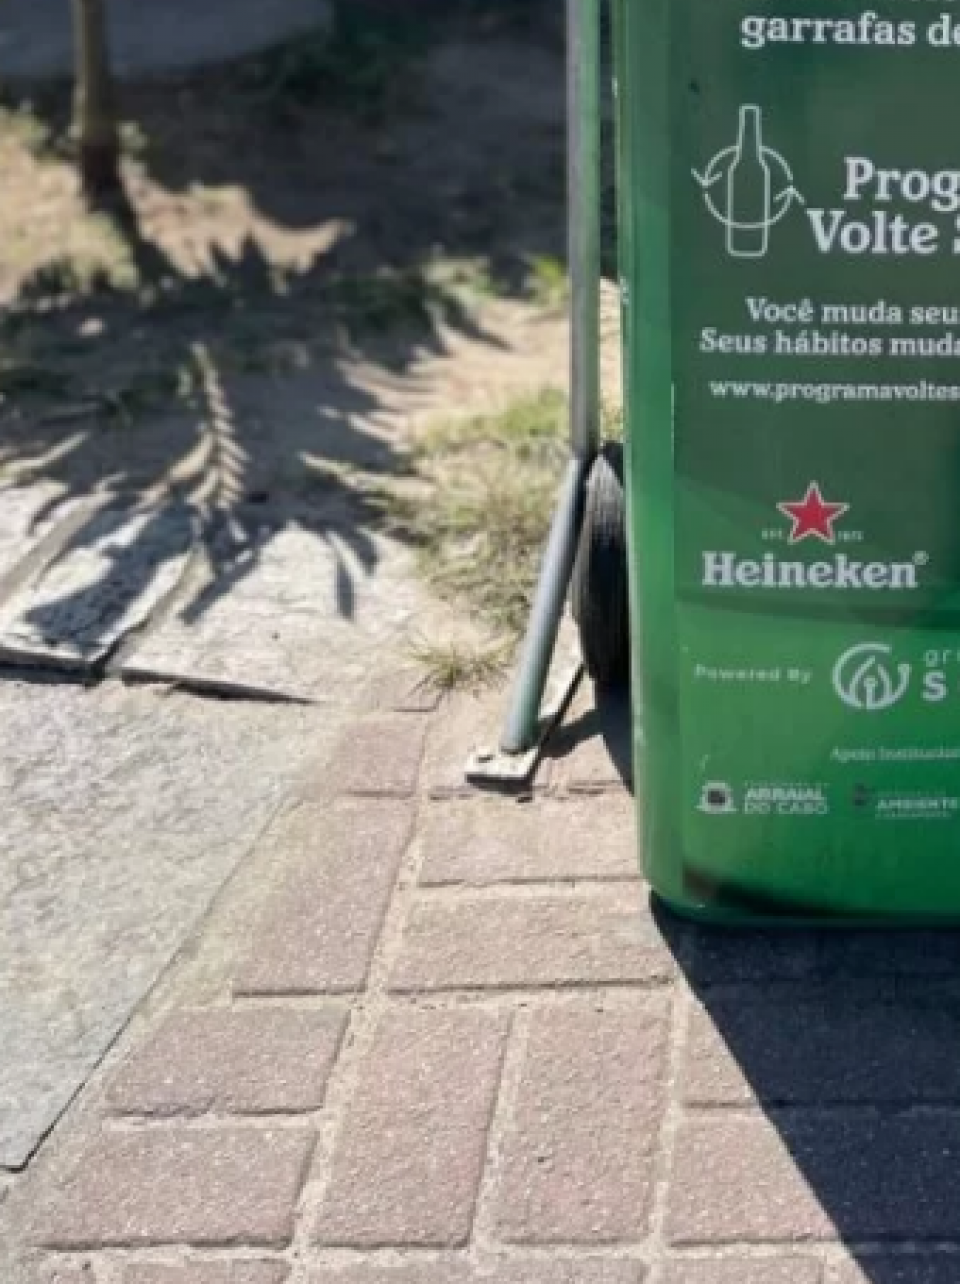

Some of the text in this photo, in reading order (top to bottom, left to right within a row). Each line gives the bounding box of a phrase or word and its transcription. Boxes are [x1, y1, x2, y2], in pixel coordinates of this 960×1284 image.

[740, 11, 916, 48] garrafas
[806, 208, 939, 255] Volte
[745, 297, 814, 323] Você
[821, 300, 901, 324] muda
[700, 328, 768, 353] Seus
[775, 330, 882, 355] hábitos
